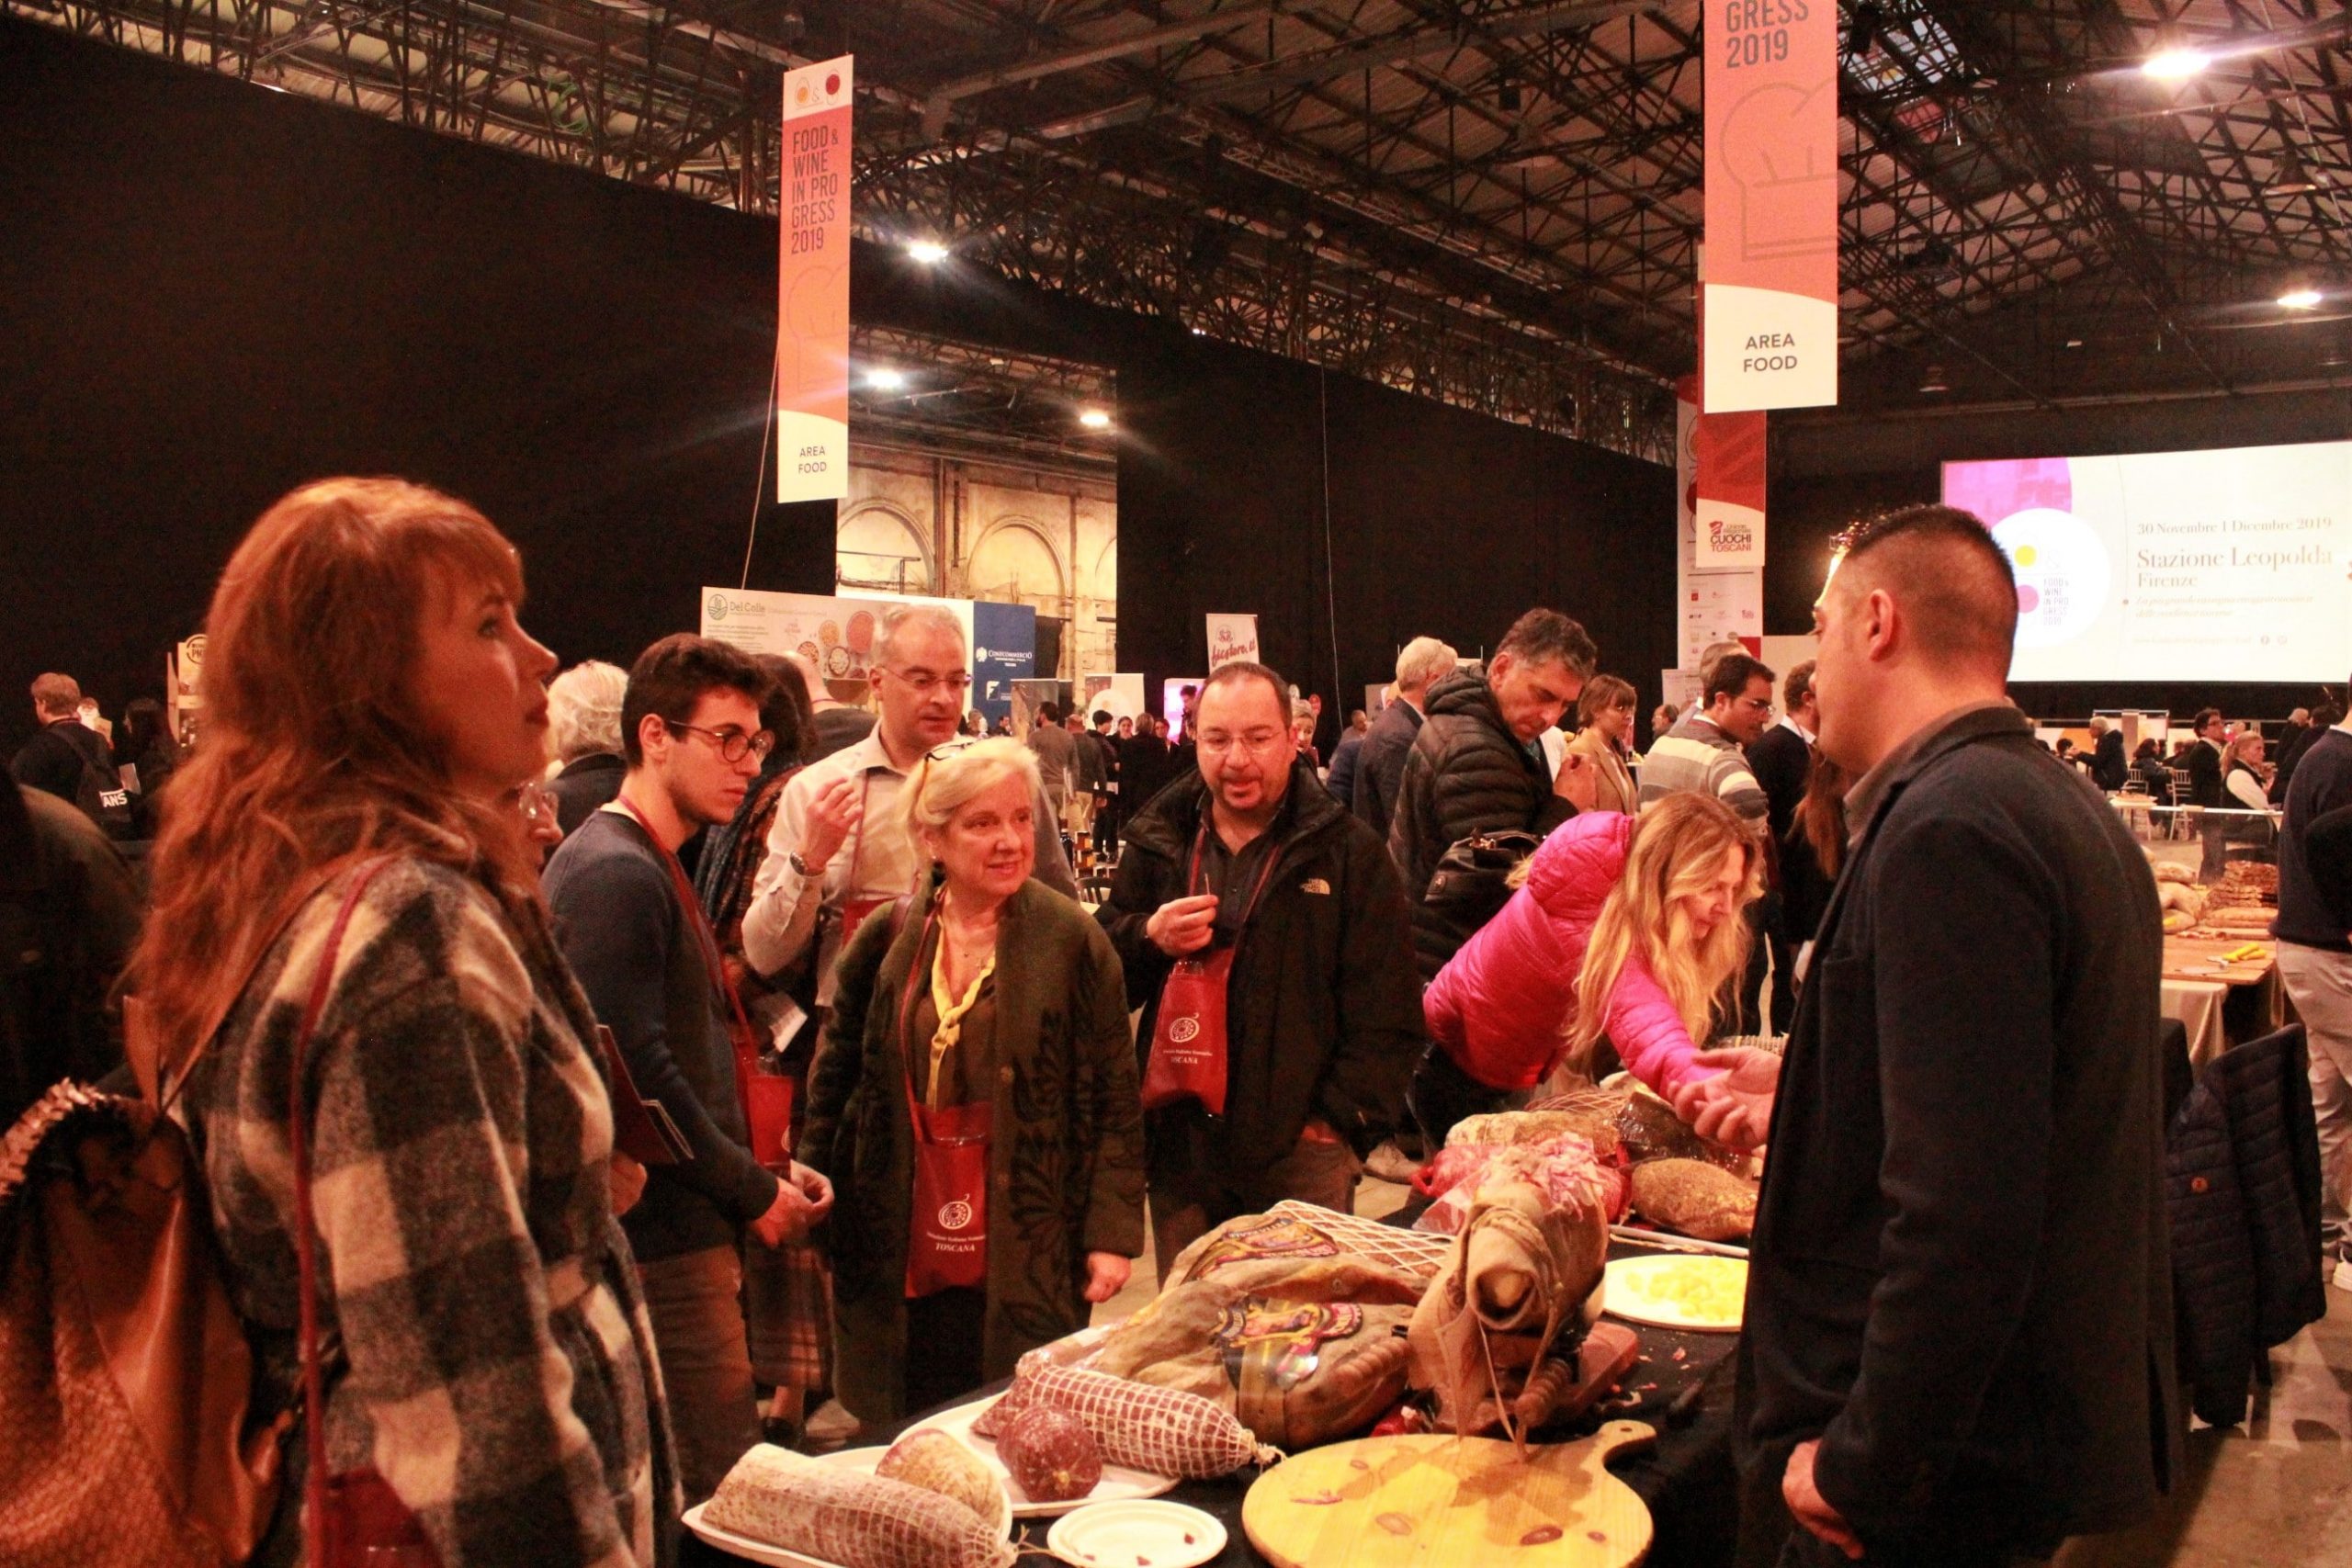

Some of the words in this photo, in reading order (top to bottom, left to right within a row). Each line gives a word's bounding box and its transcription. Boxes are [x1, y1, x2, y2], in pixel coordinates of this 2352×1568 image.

[1726, 0, 1808, 33] GRESS
[1726, 28, 1788, 68] 2019
[793, 125, 829, 154] FOOD
[831, 129, 839, 145] &
[793, 150, 829, 178] WINE
[792, 180, 806, 204] IN
[811, 173, 838, 199] PRO
[791, 198, 836, 229] GRESS
[791, 226, 824, 254] 2019
[1746, 333, 1795, 351] AREA
[1744, 355, 1798, 373] FOOD
[799, 446, 826, 457] AREA
[797, 460, 827, 475] FOOD
[2137, 522, 2154, 535] 30
[2156, 521, 2218, 535] Novembre
[2231, 519, 2293, 533] Dicembre
[2296, 516, 2332, 530] 2019
[1710, 534, 1751, 544] CUOCHI
[1710, 544, 1751, 553] TOSCANI
[2137, 547, 2225, 569] Stazione
[2232, 545, 2333, 572] Leopolda
[2137, 572, 2199, 589] Firenze
[729, 602, 743, 612] Del
[745, 602, 766, 613] Colle
[935, 1243, 975, 1253] TOSCANA
